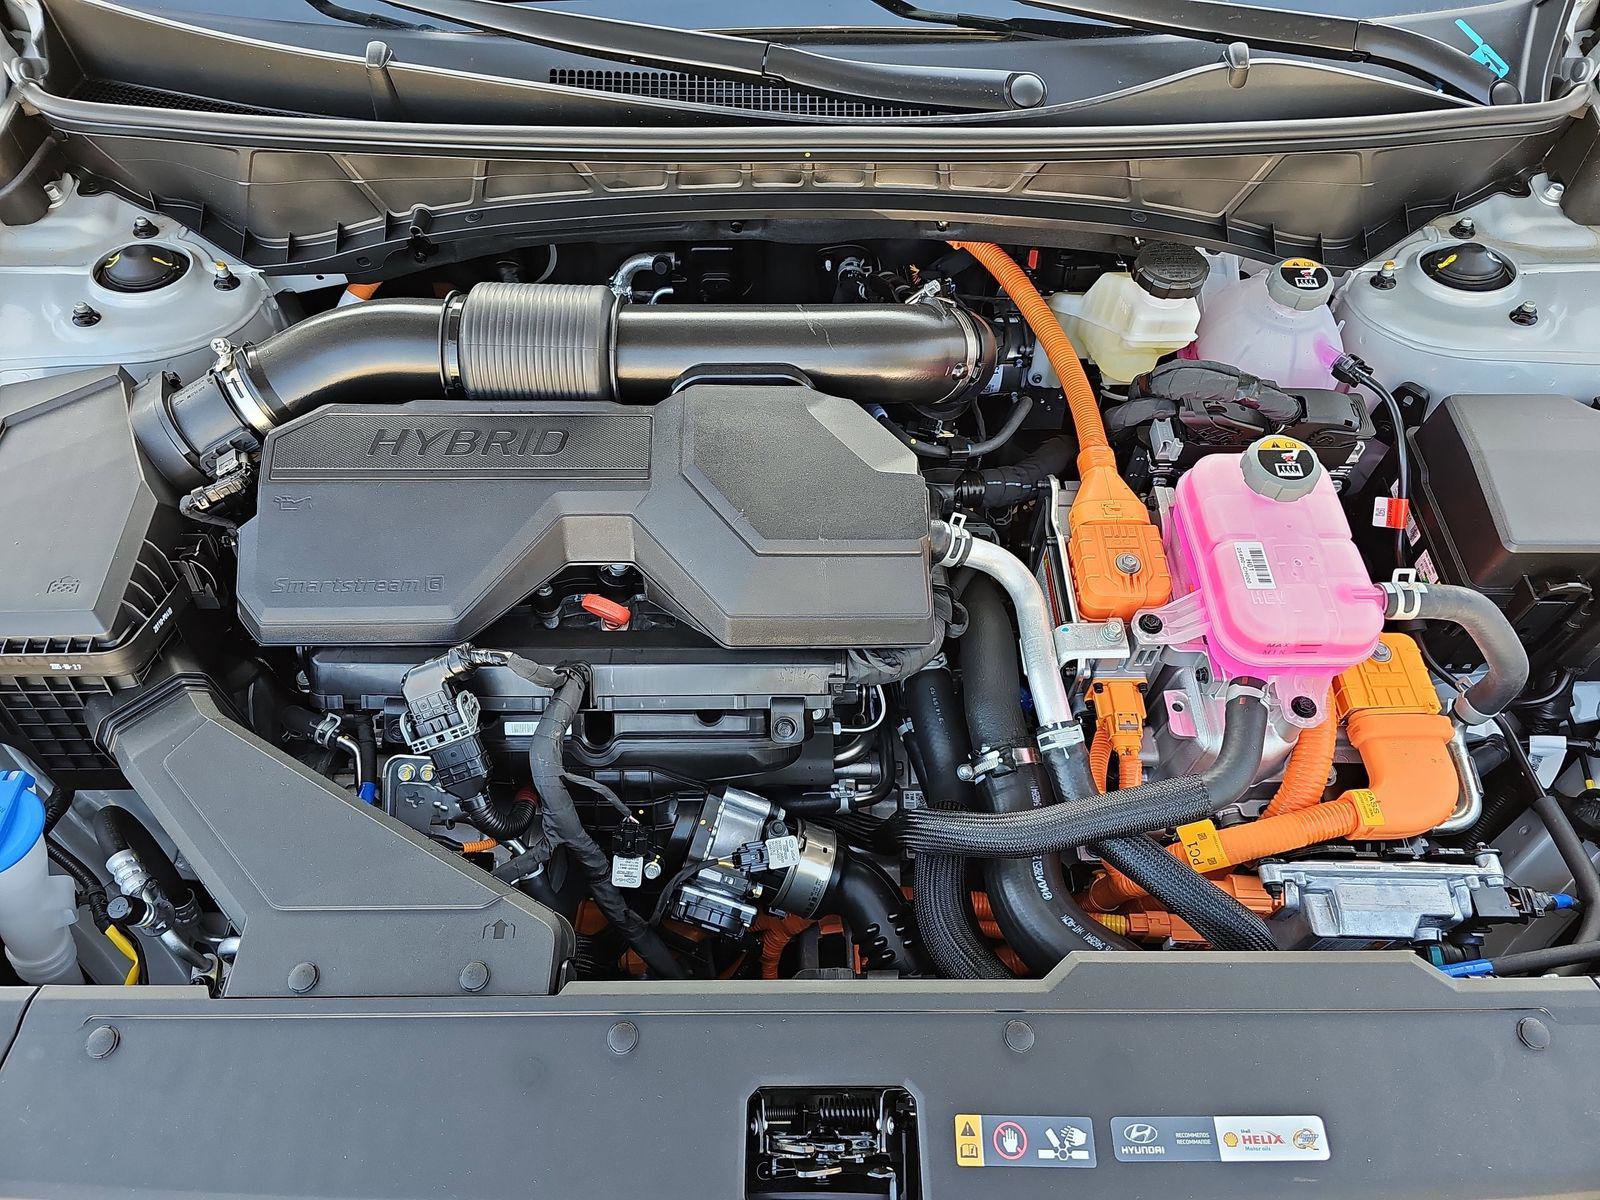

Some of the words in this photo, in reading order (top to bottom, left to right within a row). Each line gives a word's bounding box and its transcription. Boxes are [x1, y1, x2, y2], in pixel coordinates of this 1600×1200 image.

[366, 427, 571, 457] HYBRID
[270, 576, 425, 595] Smartstream
[1188, 840, 1204, 867] PC1
[1242, 1135, 1284, 1145] HELIX
[1121, 1146, 1165, 1154] HYUNDAI
